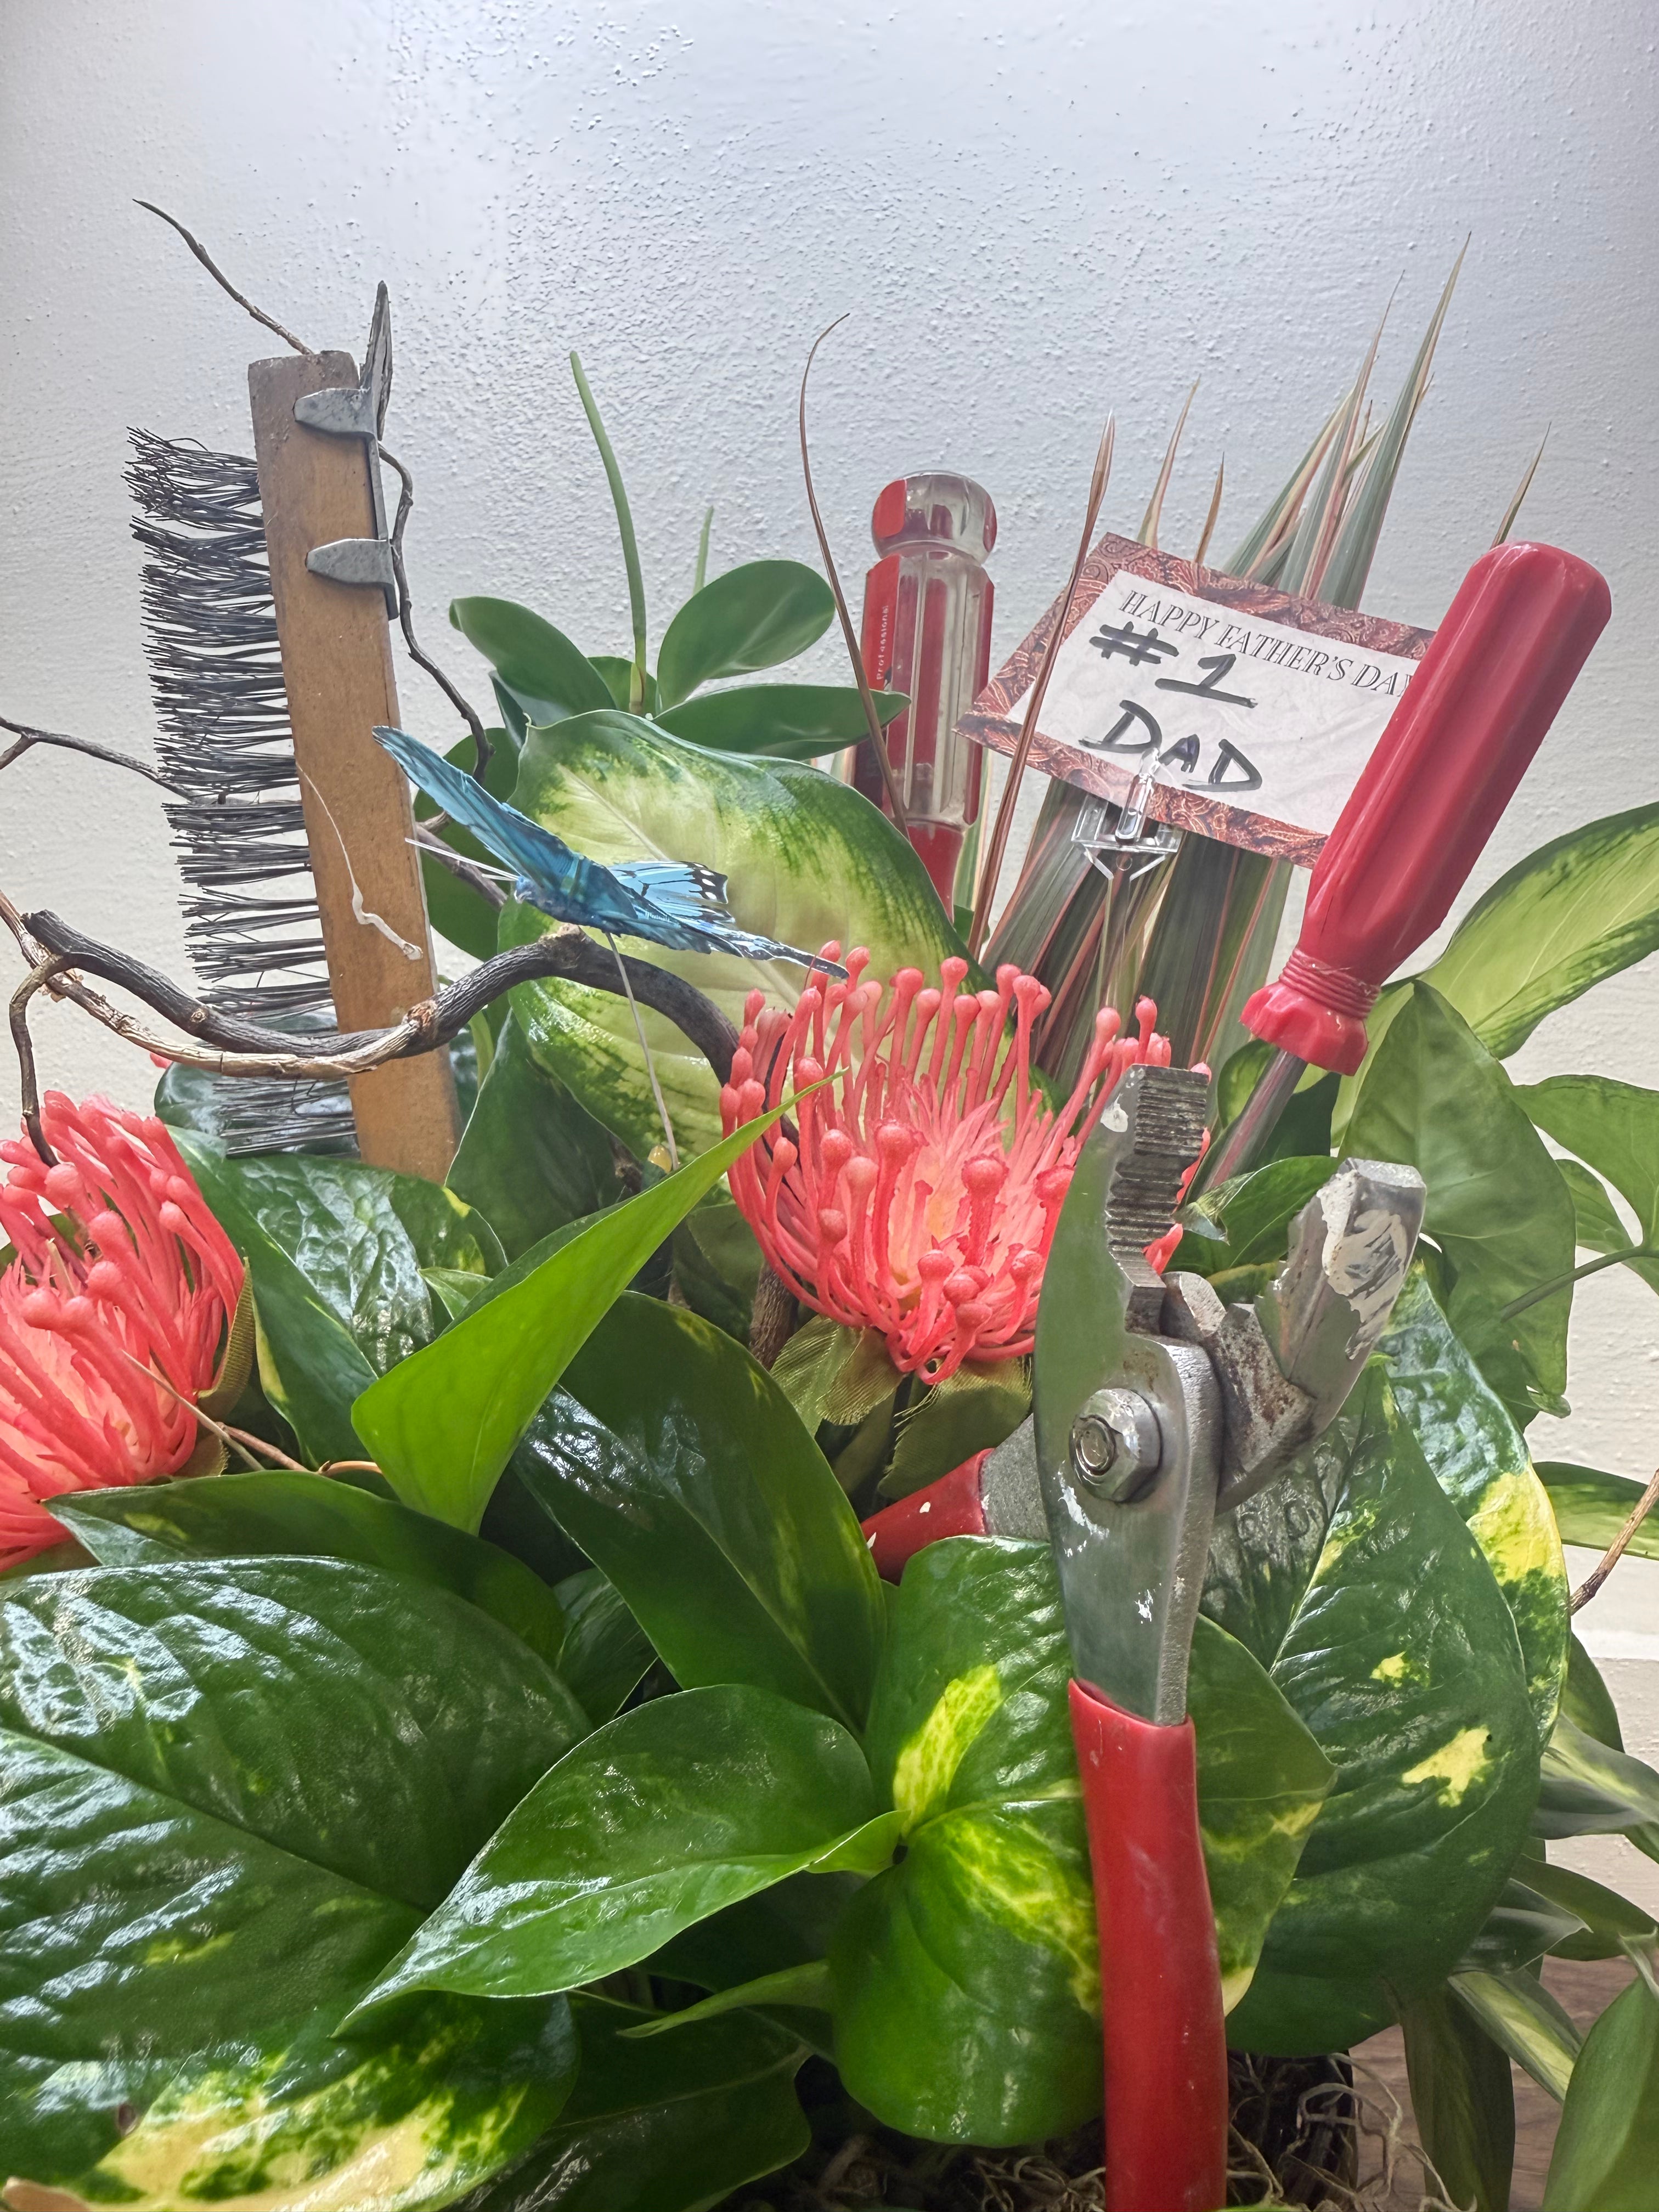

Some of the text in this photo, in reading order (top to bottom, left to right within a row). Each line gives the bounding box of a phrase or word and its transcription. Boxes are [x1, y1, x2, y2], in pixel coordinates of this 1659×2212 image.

[1118, 590, 1220, 640] HAPPY
[1214, 624, 1353, 681] FATHER'S
[1079, 699, 1262, 792] DAD
